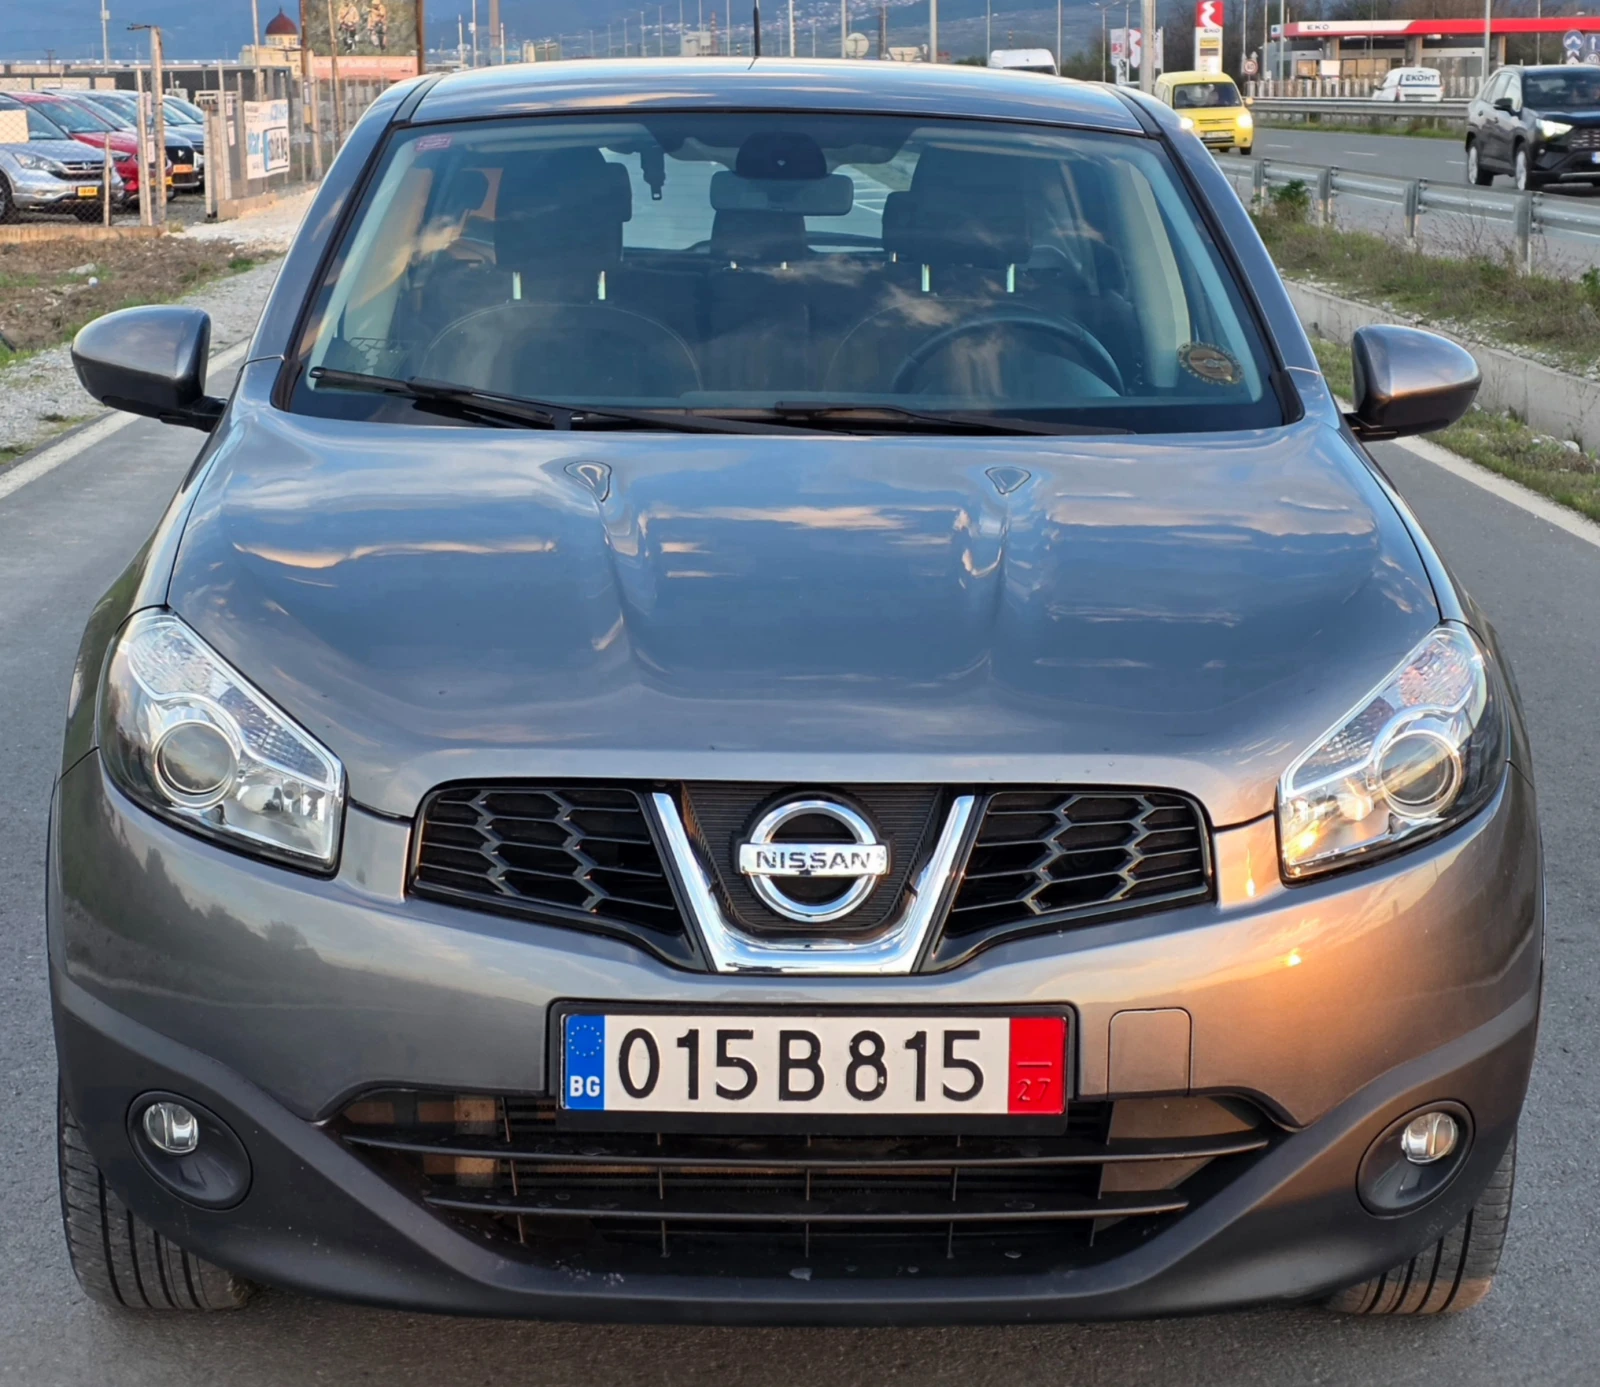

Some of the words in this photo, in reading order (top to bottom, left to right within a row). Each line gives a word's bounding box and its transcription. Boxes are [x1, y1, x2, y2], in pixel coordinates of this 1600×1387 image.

[756, 850, 871, 870] NISSAN
[618, 1028, 985, 1102] 015B815
[570, 1075, 601, 1097] BG
[1016, 1077, 1052, 1102] 27
